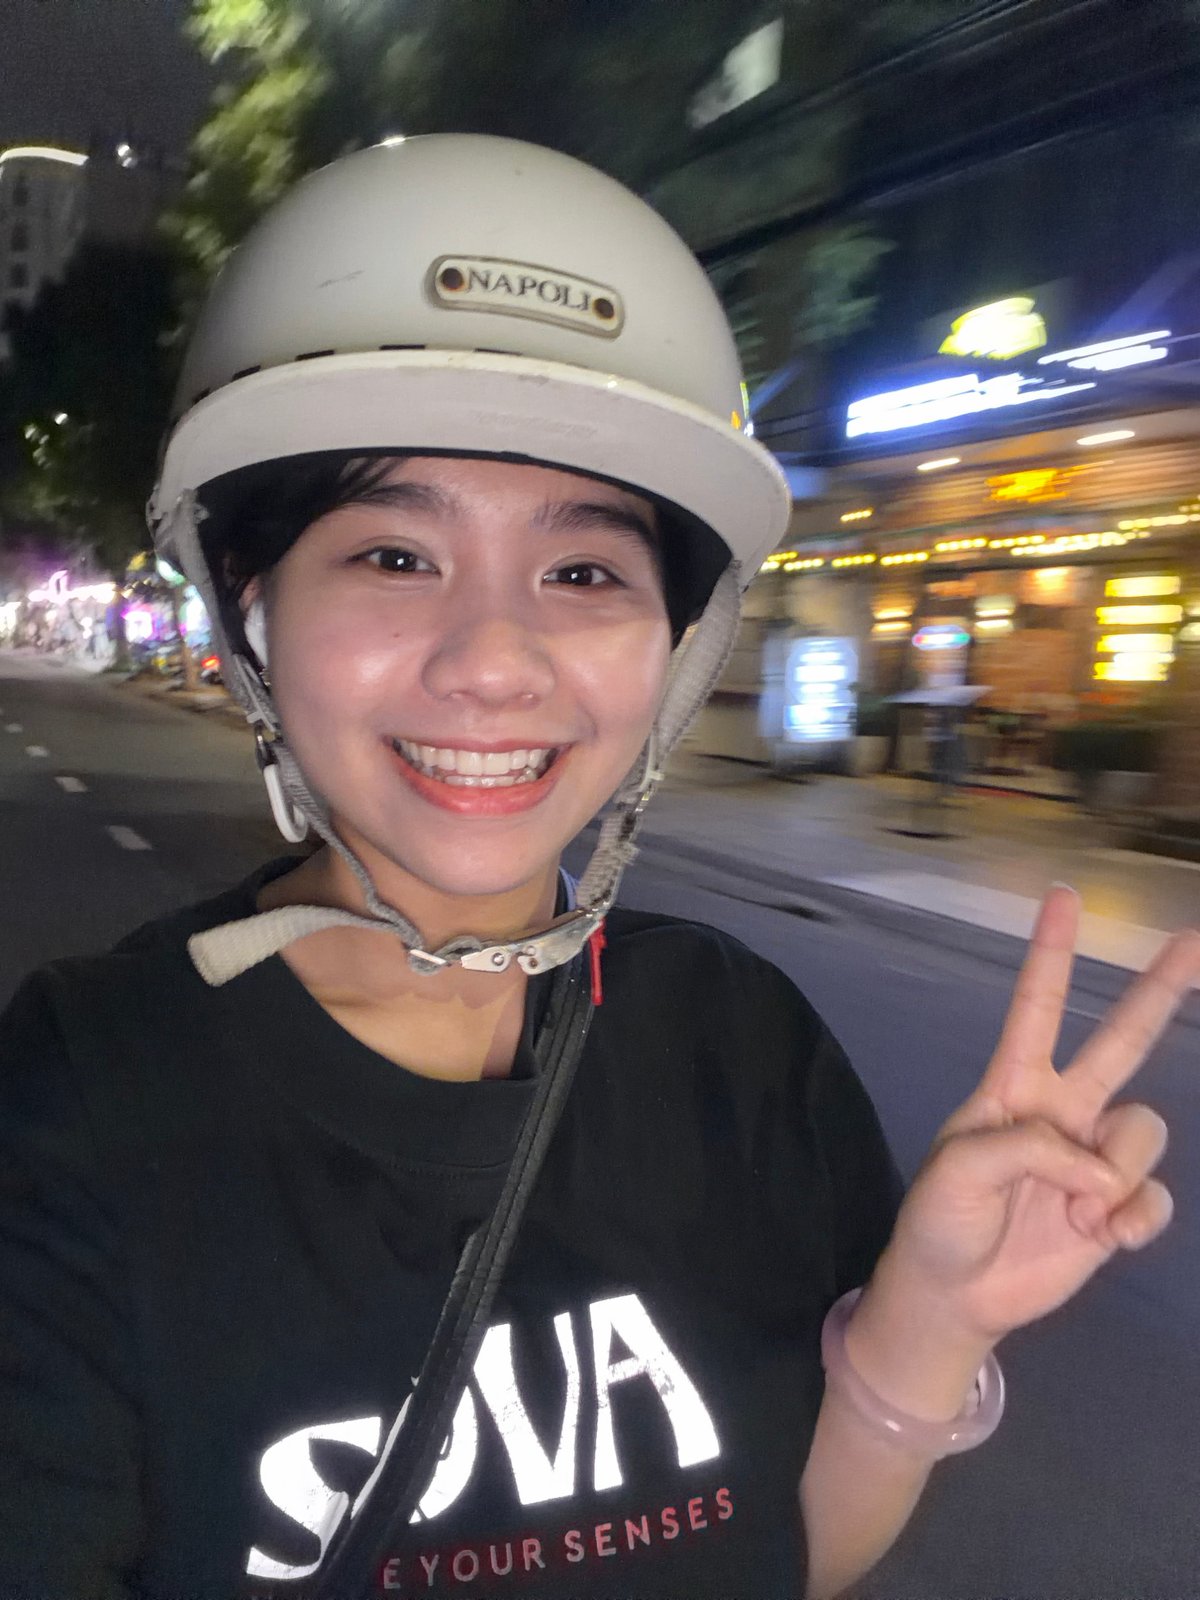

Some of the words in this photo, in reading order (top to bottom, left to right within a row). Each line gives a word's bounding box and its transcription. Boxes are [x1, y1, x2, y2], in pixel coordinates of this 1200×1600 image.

[466, 267, 591, 311] NAPOLI
[419, 1538, 546, 1587] YOUR
[563, 1487, 734, 1562] SENSES
